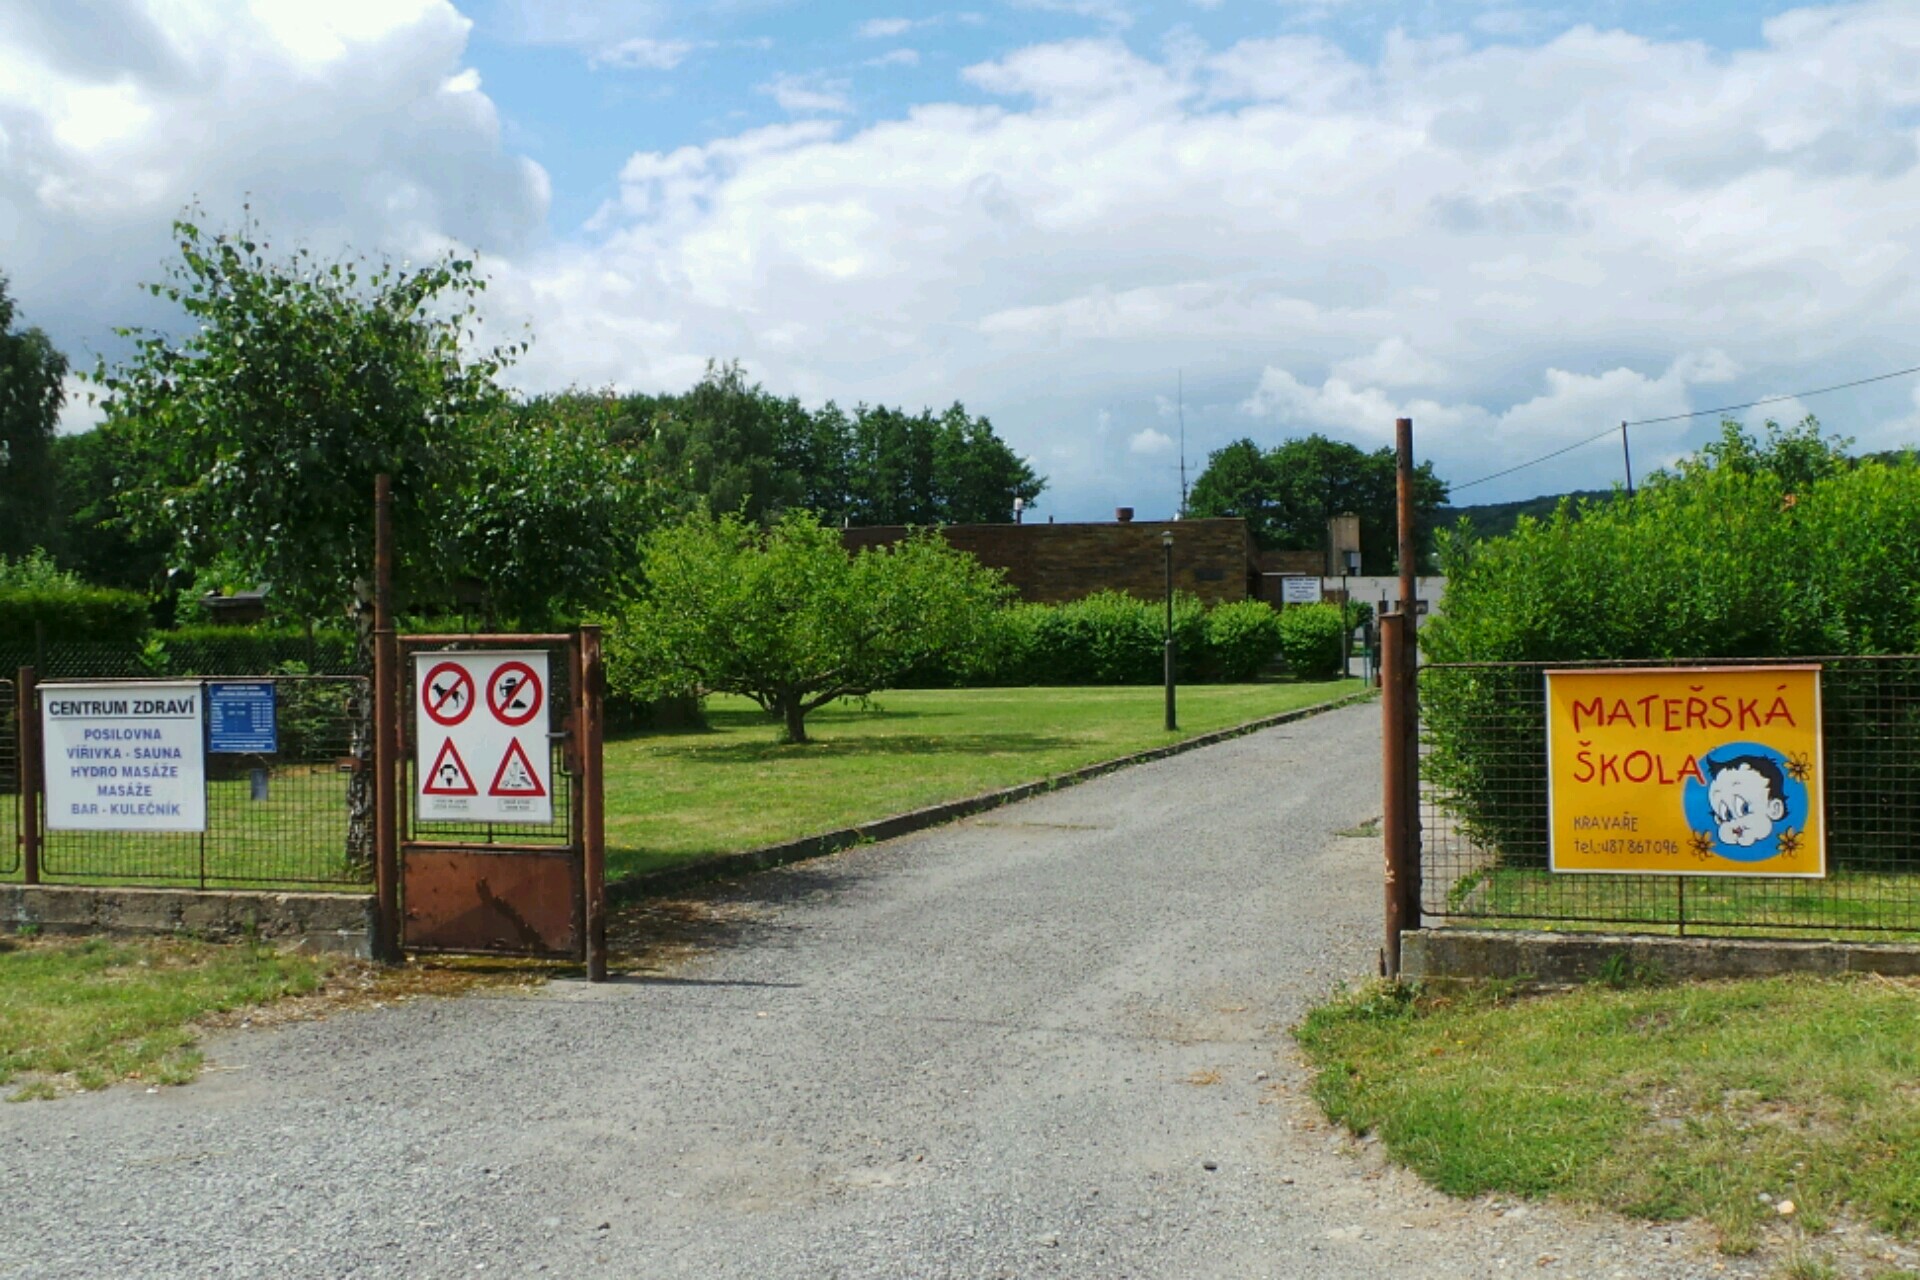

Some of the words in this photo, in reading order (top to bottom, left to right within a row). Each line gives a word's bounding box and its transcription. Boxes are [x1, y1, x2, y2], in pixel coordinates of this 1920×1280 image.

[49, 700, 128, 716] CENTRUM
[133, 695, 195, 714] ZDRAVÍ
[1572, 684, 1796, 733] MATEŘSKÁ
[84, 728, 162, 740] POSILOVNA
[67, 745, 121, 759] VÍŘIVKA
[133, 748, 182, 759] SAUNA
[71, 766, 117, 778] HYDRO
[122, 762, 178, 778] MASÁŽE
[1573, 740, 1707, 786] ŠKOLA
[98, 783, 152, 797] MASÁŽE
[71, 804, 98, 815] BAR
[110, 803, 181, 816] KULEČNÍK
[1574, 811, 1638, 832] KRAVAŘE
